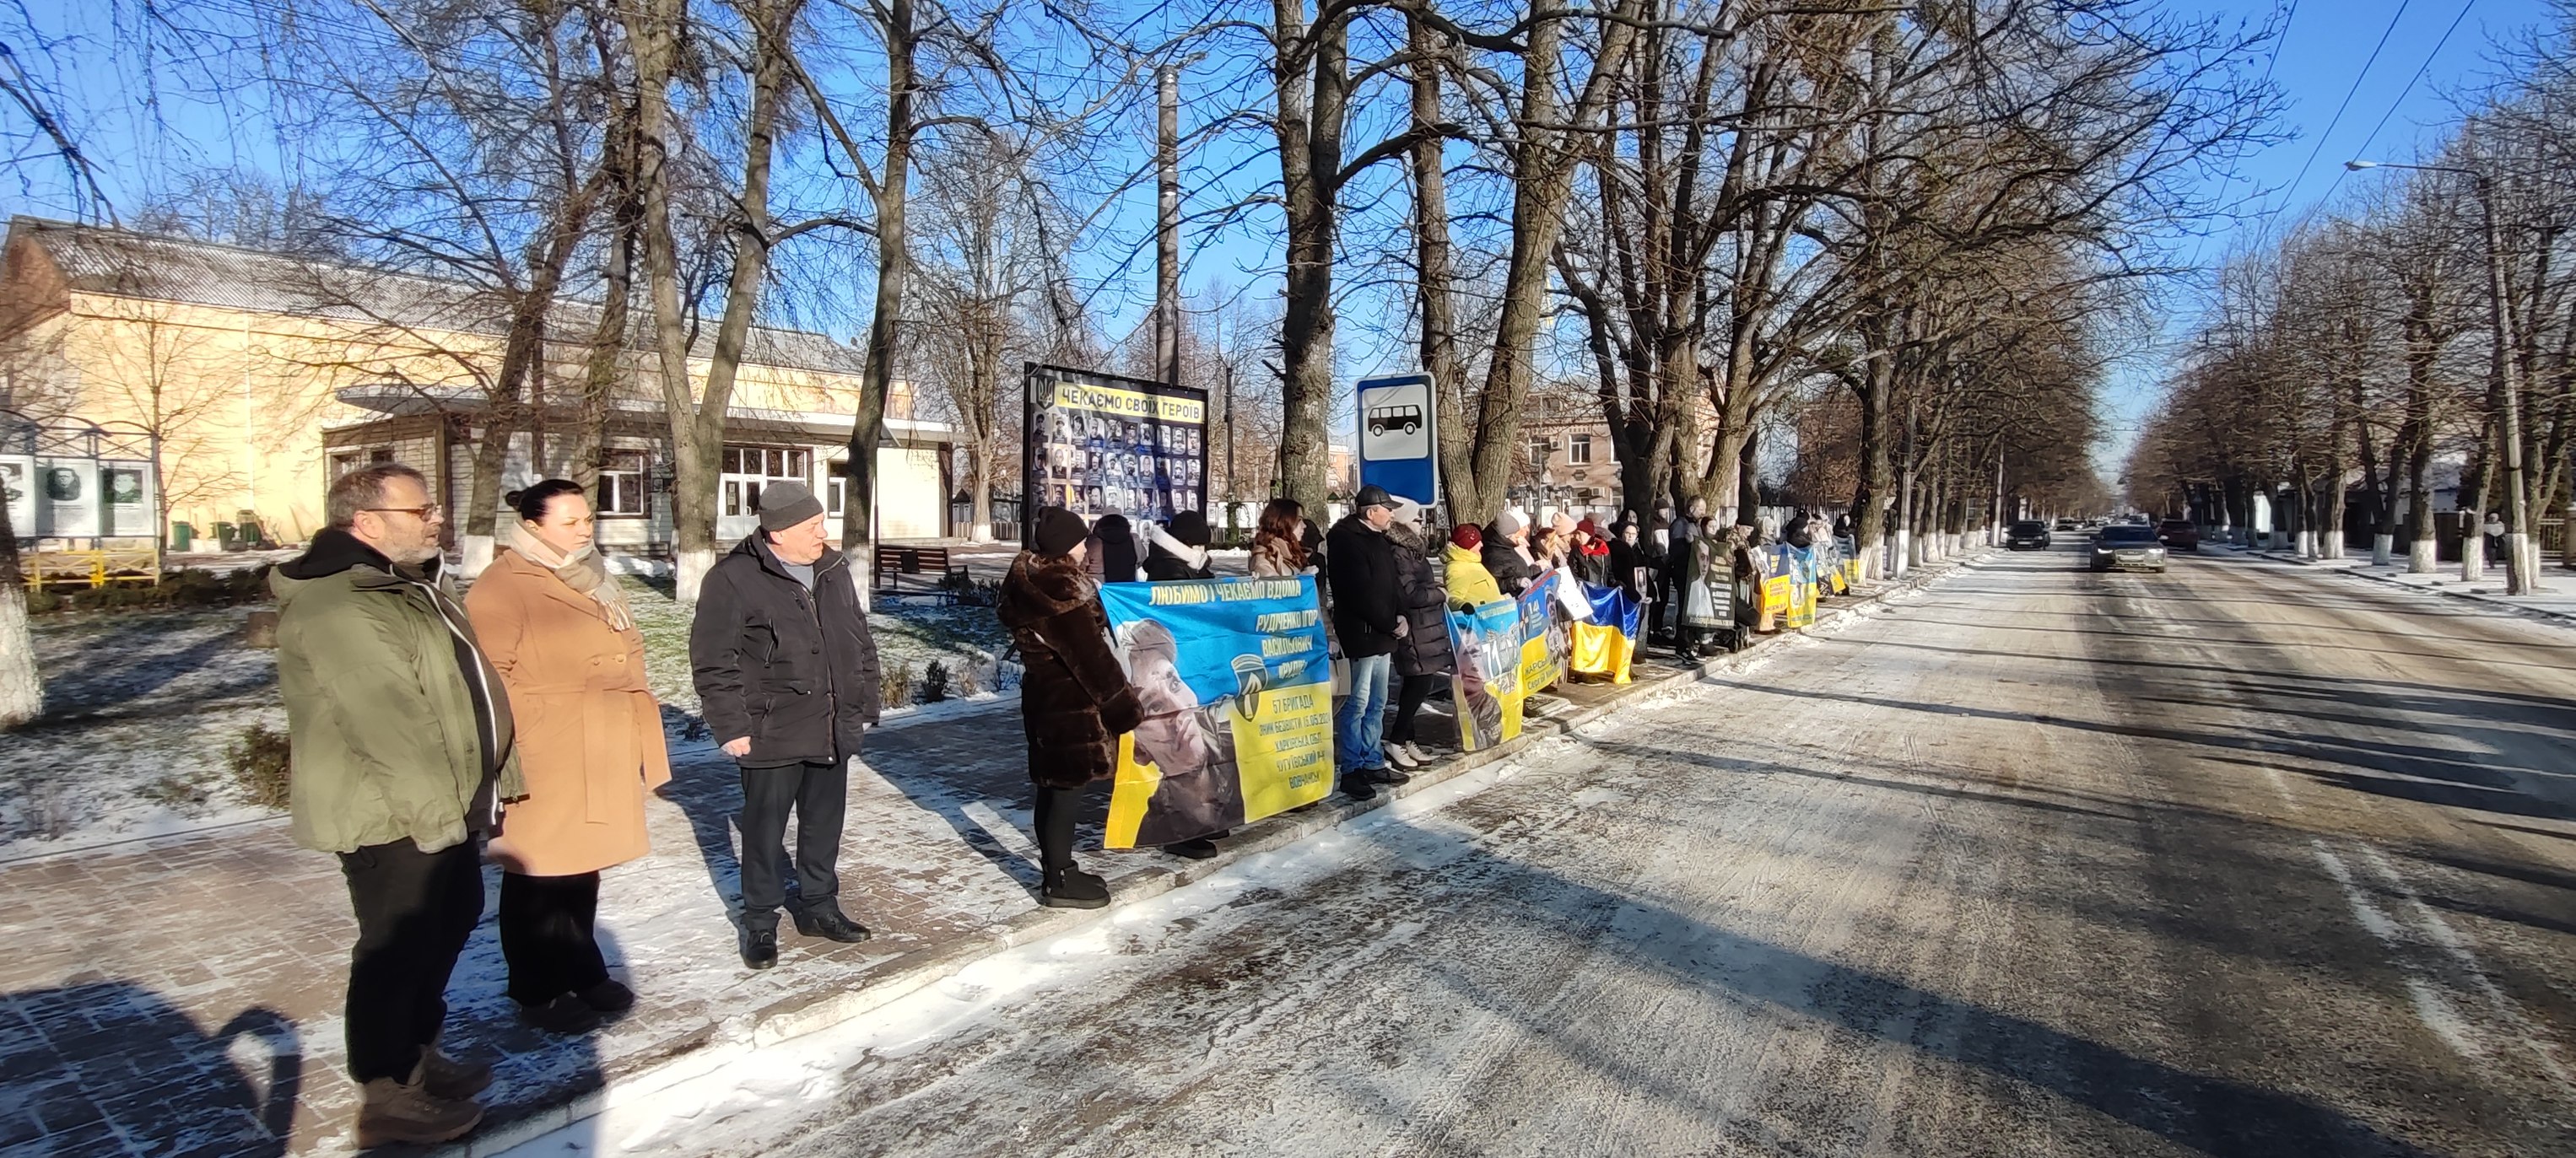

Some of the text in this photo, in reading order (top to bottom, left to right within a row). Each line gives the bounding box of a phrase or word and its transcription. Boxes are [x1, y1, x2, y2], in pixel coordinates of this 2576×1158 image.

[1062, 388, 1200, 419] ЧЕКАЄМО СВОЇХ ГЕРОЇВ
[1148, 584, 1207, 606] ЛЮБИМО
[1216, 580, 1265, 602] ЧЕКАЄМО
[1267, 579, 1301, 600] ВДОМА
[1302, 609, 1318, 627] ІГОР
[1261, 634, 1313, 657] ВАСИЛЬОВИЧ
[1272, 694, 1314, 714] 57 БРИГАДА
